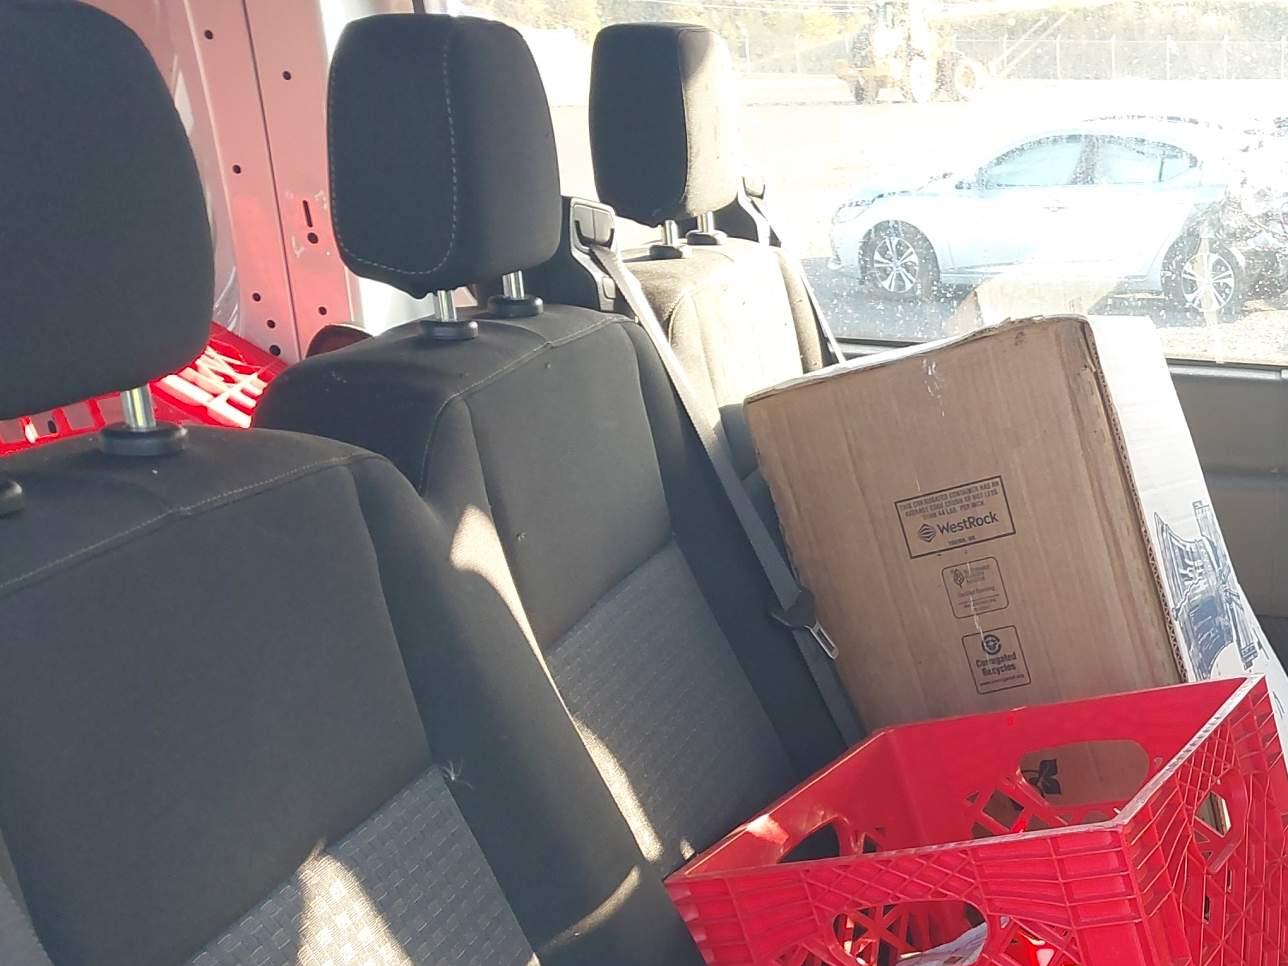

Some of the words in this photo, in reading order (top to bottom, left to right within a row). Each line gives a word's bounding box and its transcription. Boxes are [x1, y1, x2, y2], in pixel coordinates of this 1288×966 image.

[936, 511, 999, 535] WestRock
[975, 651, 1017, 668] Corrugated
[981, 664, 1017, 677] Recycles
